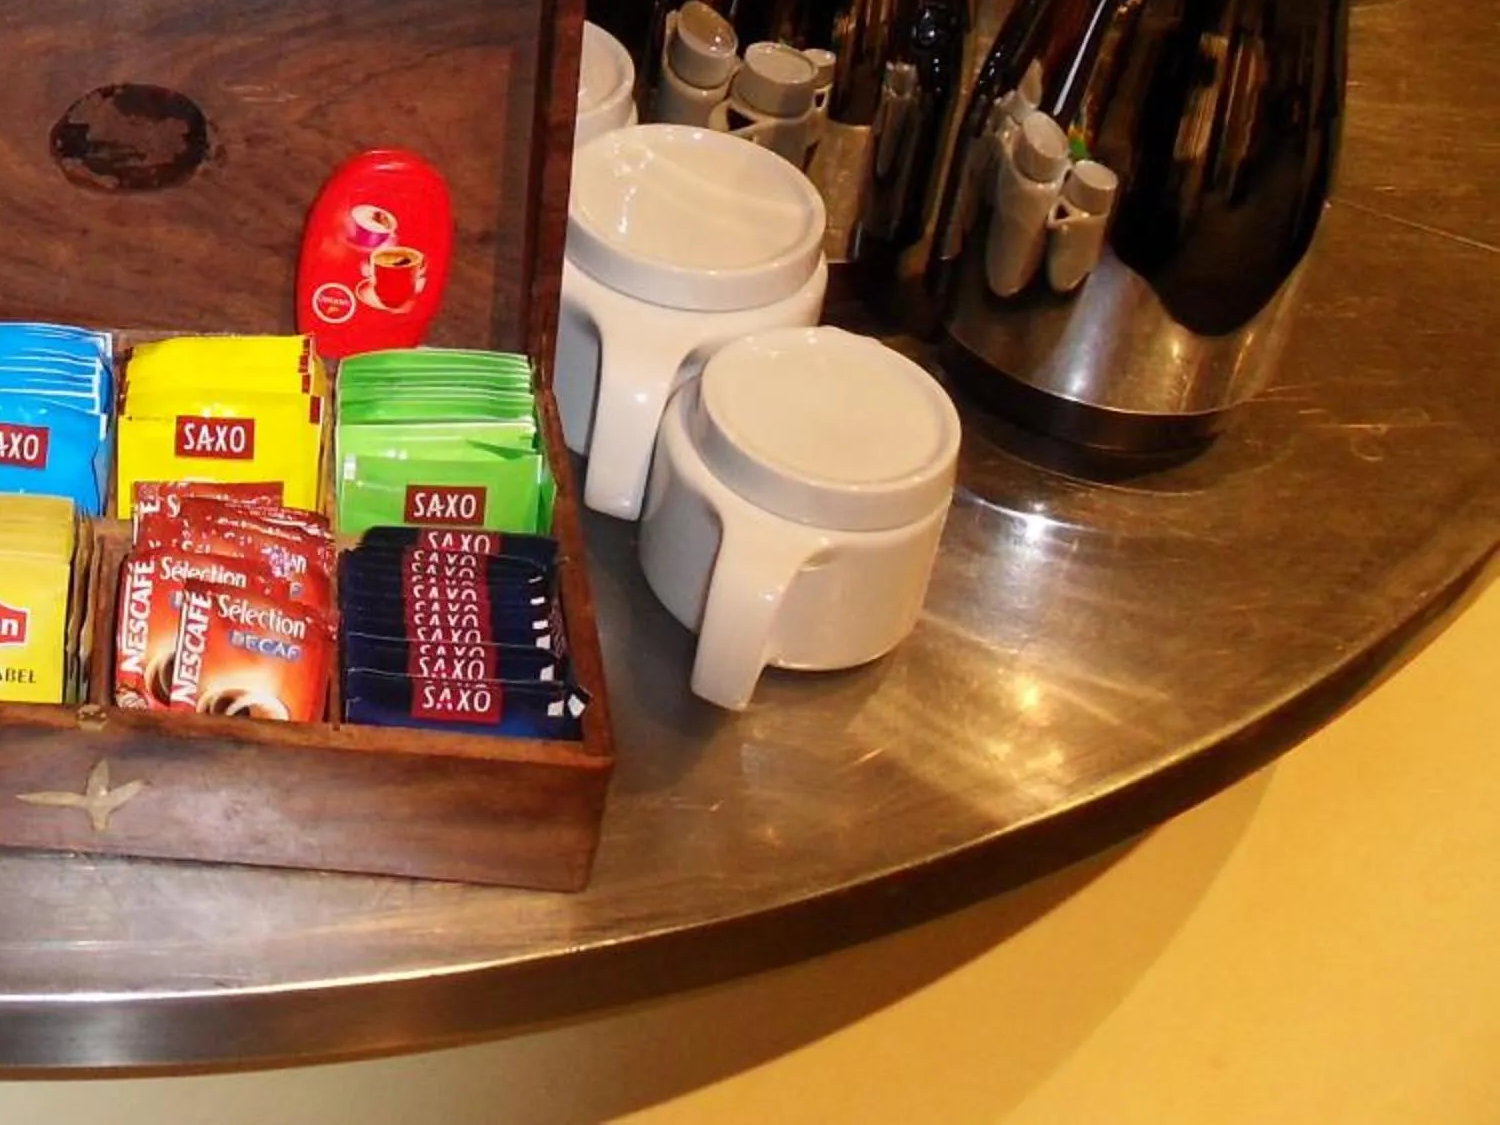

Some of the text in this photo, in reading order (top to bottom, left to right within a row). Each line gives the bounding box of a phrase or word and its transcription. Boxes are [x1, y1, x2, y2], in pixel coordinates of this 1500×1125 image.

[184, 423, 245, 453] SAXO
[413, 492, 477, 519] SAXO
[217, 594, 306, 639] Sélection
[422, 685, 491, 713] SAXO
